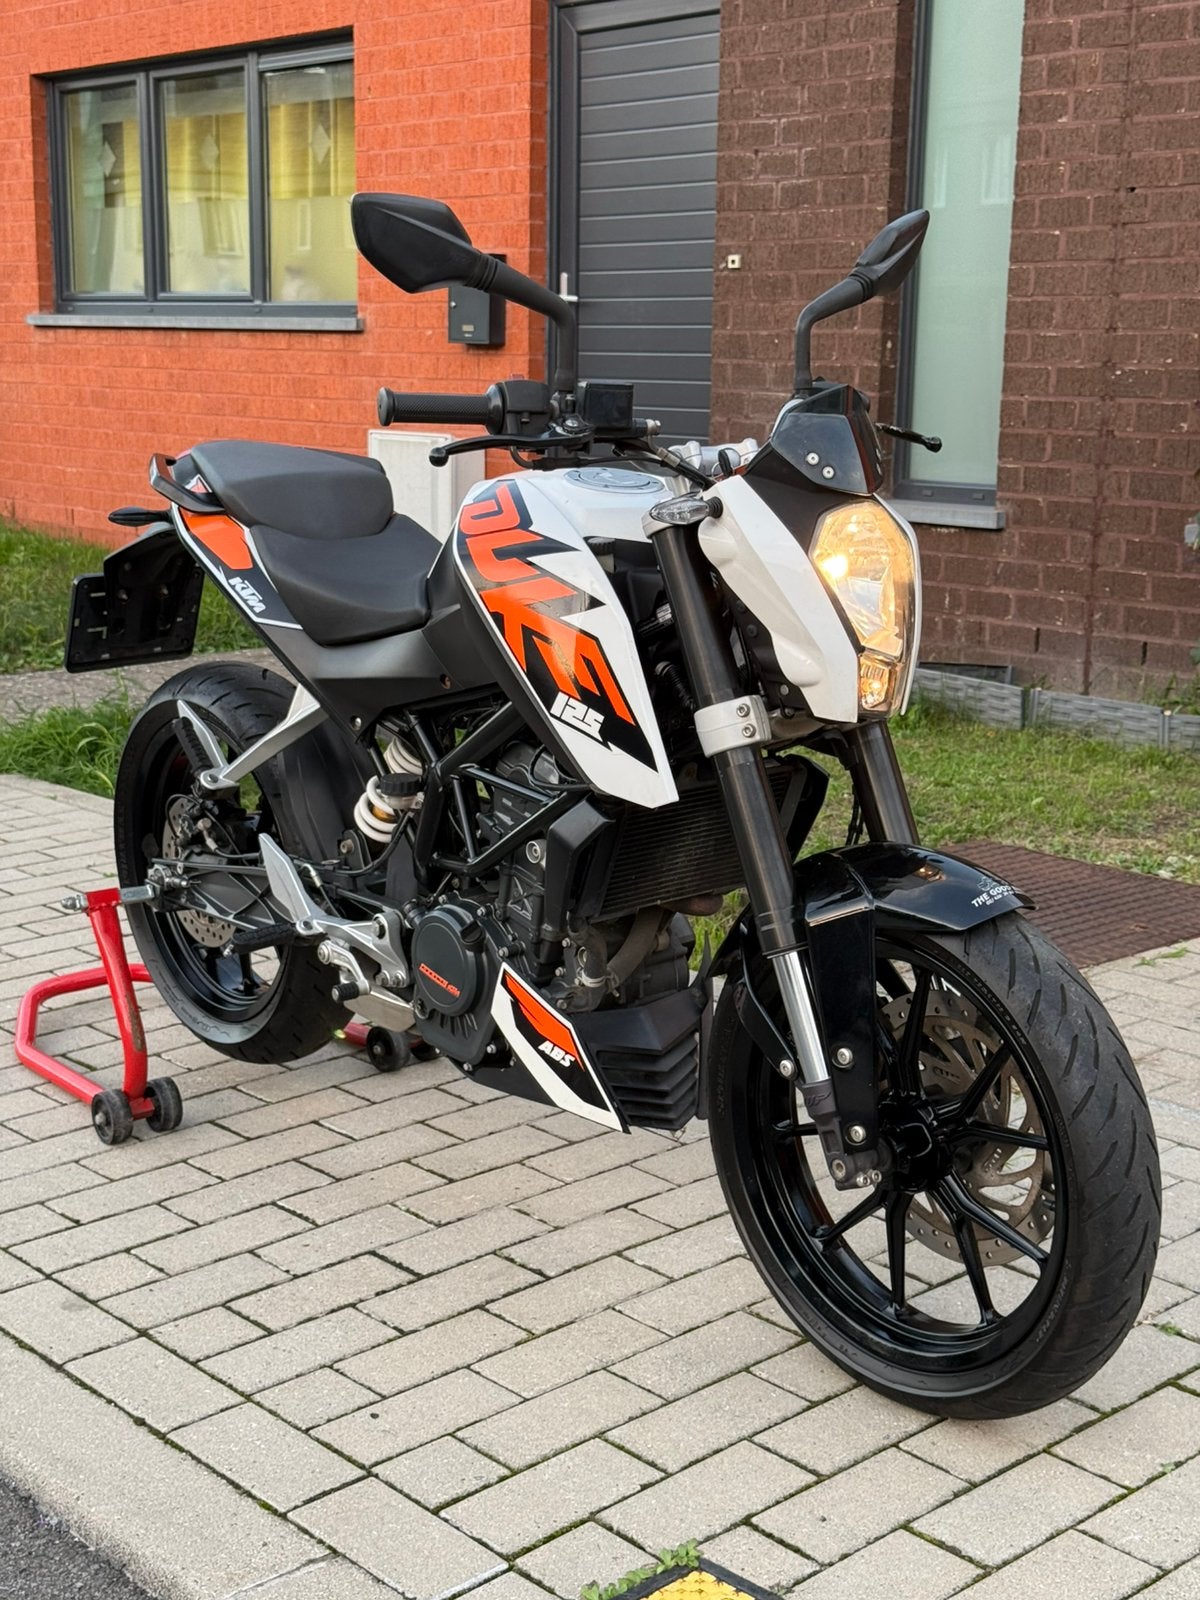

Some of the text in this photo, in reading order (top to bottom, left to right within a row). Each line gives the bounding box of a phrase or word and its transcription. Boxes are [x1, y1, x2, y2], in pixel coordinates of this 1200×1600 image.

[228, 577, 266, 613] KTM
[460, 482, 636, 726] DUKE
[550, 691, 605, 737] 125
[971, 891, 990, 907] THE
[538, 1040, 575, 1067] ABS
